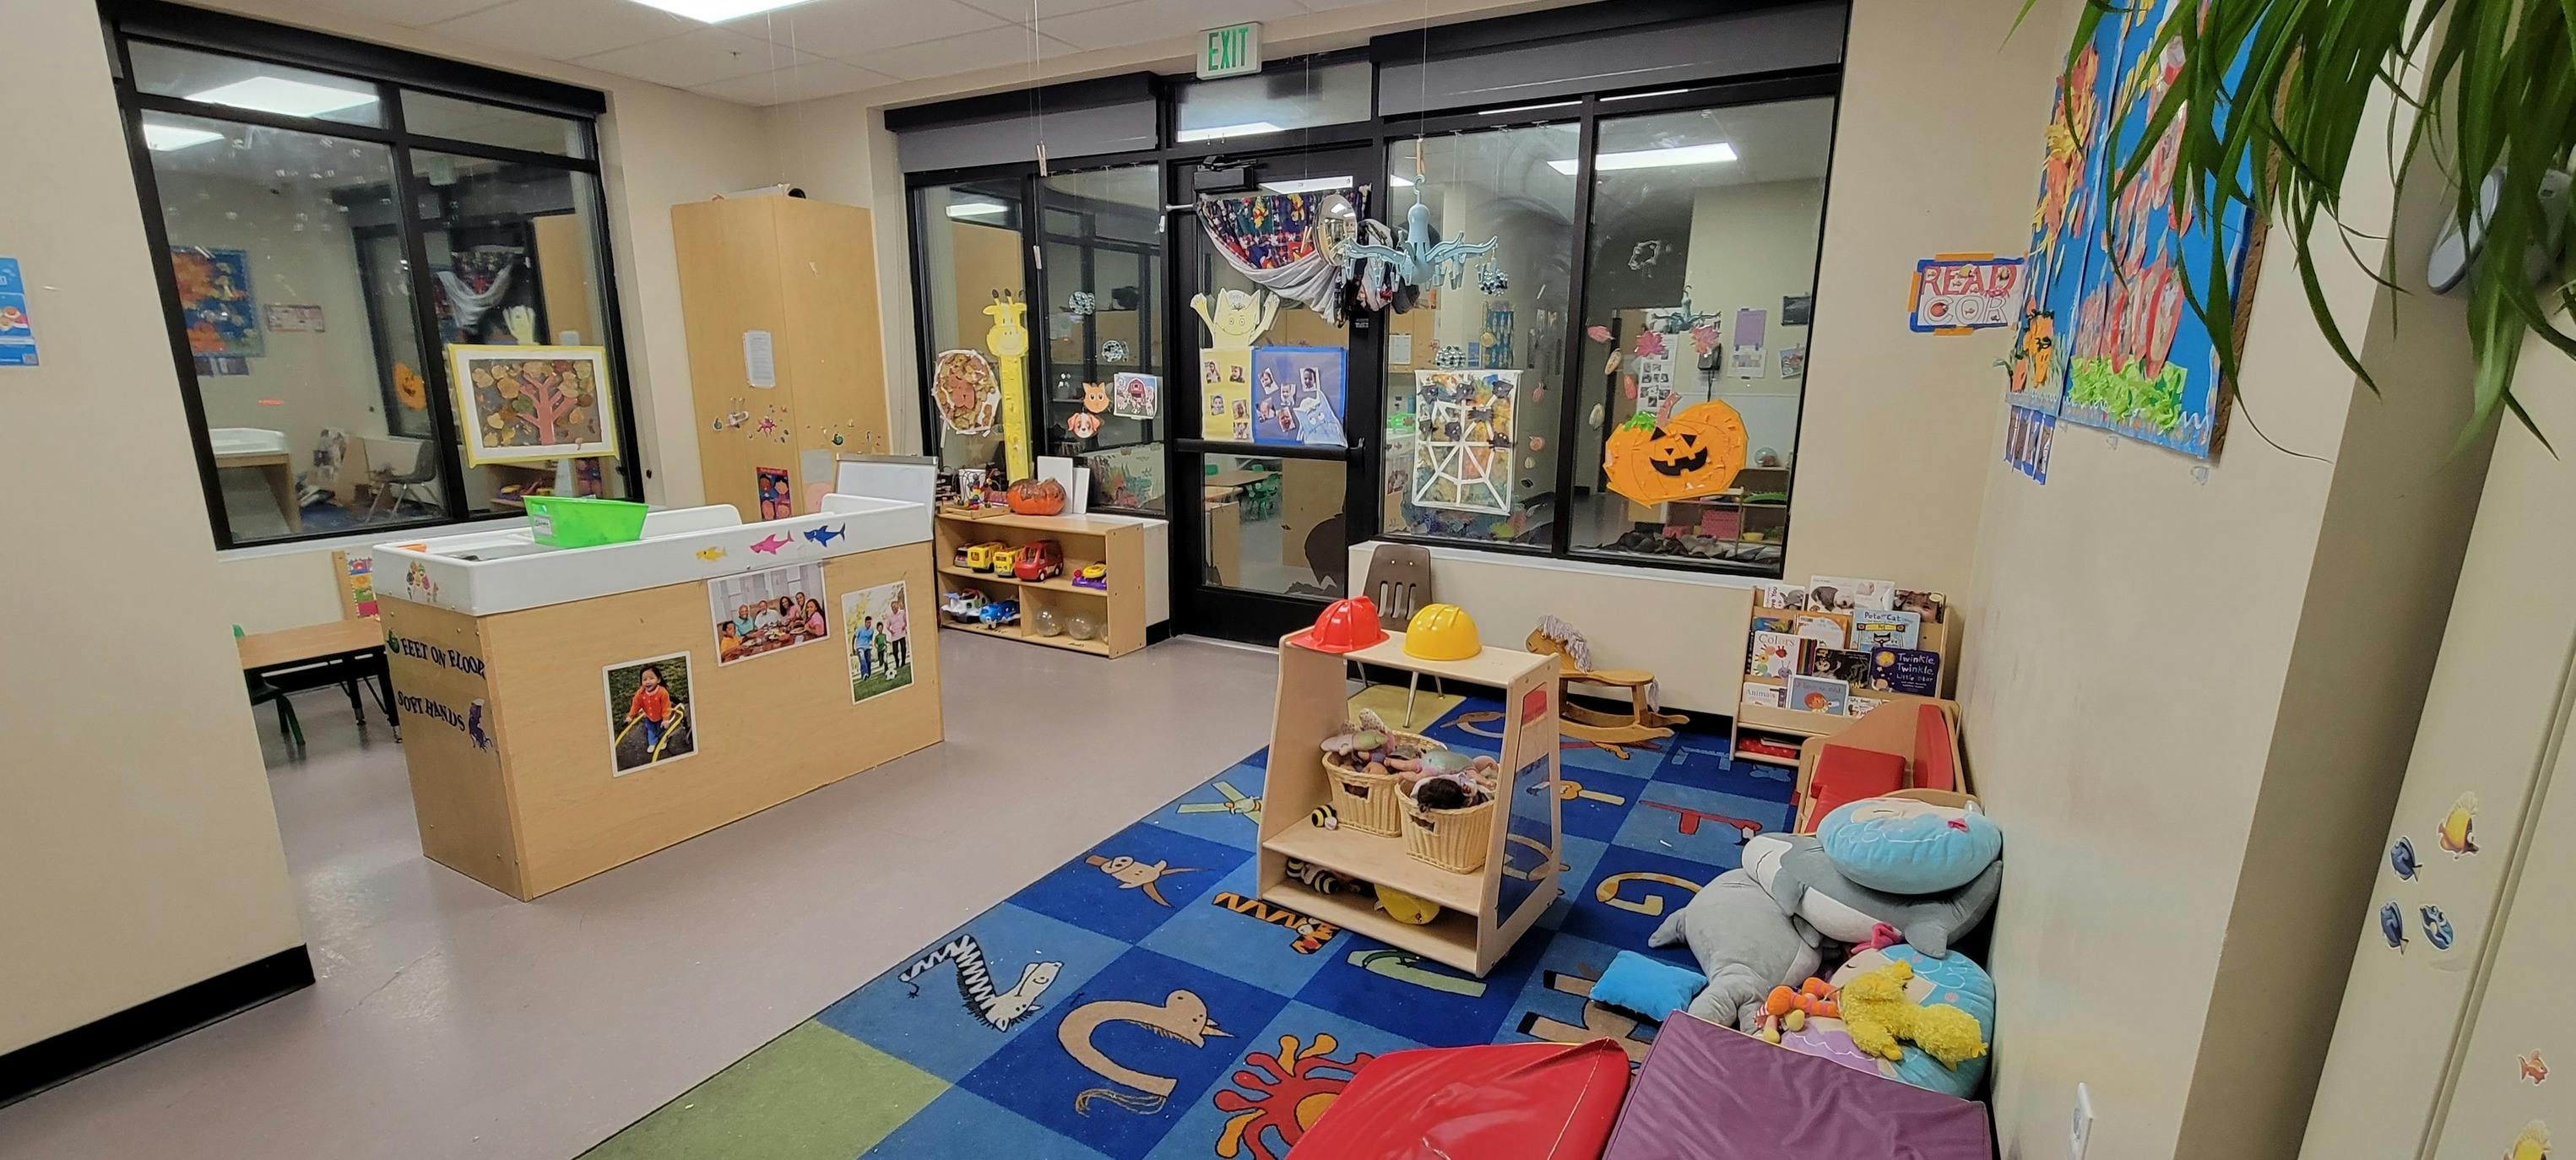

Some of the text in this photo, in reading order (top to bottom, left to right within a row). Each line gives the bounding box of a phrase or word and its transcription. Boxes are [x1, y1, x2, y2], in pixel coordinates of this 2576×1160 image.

[1208, 27, 1249, 71] EXIT
[1922, 264, 2017, 296] READ
[1923, 295, 2008, 325] COR
[1759, 633, 1795, 646] Colors
[401, 638, 486, 680] FEET ON FLOOR
[1896, 663, 1934, 675] Twinkle,
[1896, 673, 1915, 681] Little
[1746, 689, 1776, 699] Animals
[398, 691, 466, 732] SOFT HANDS
